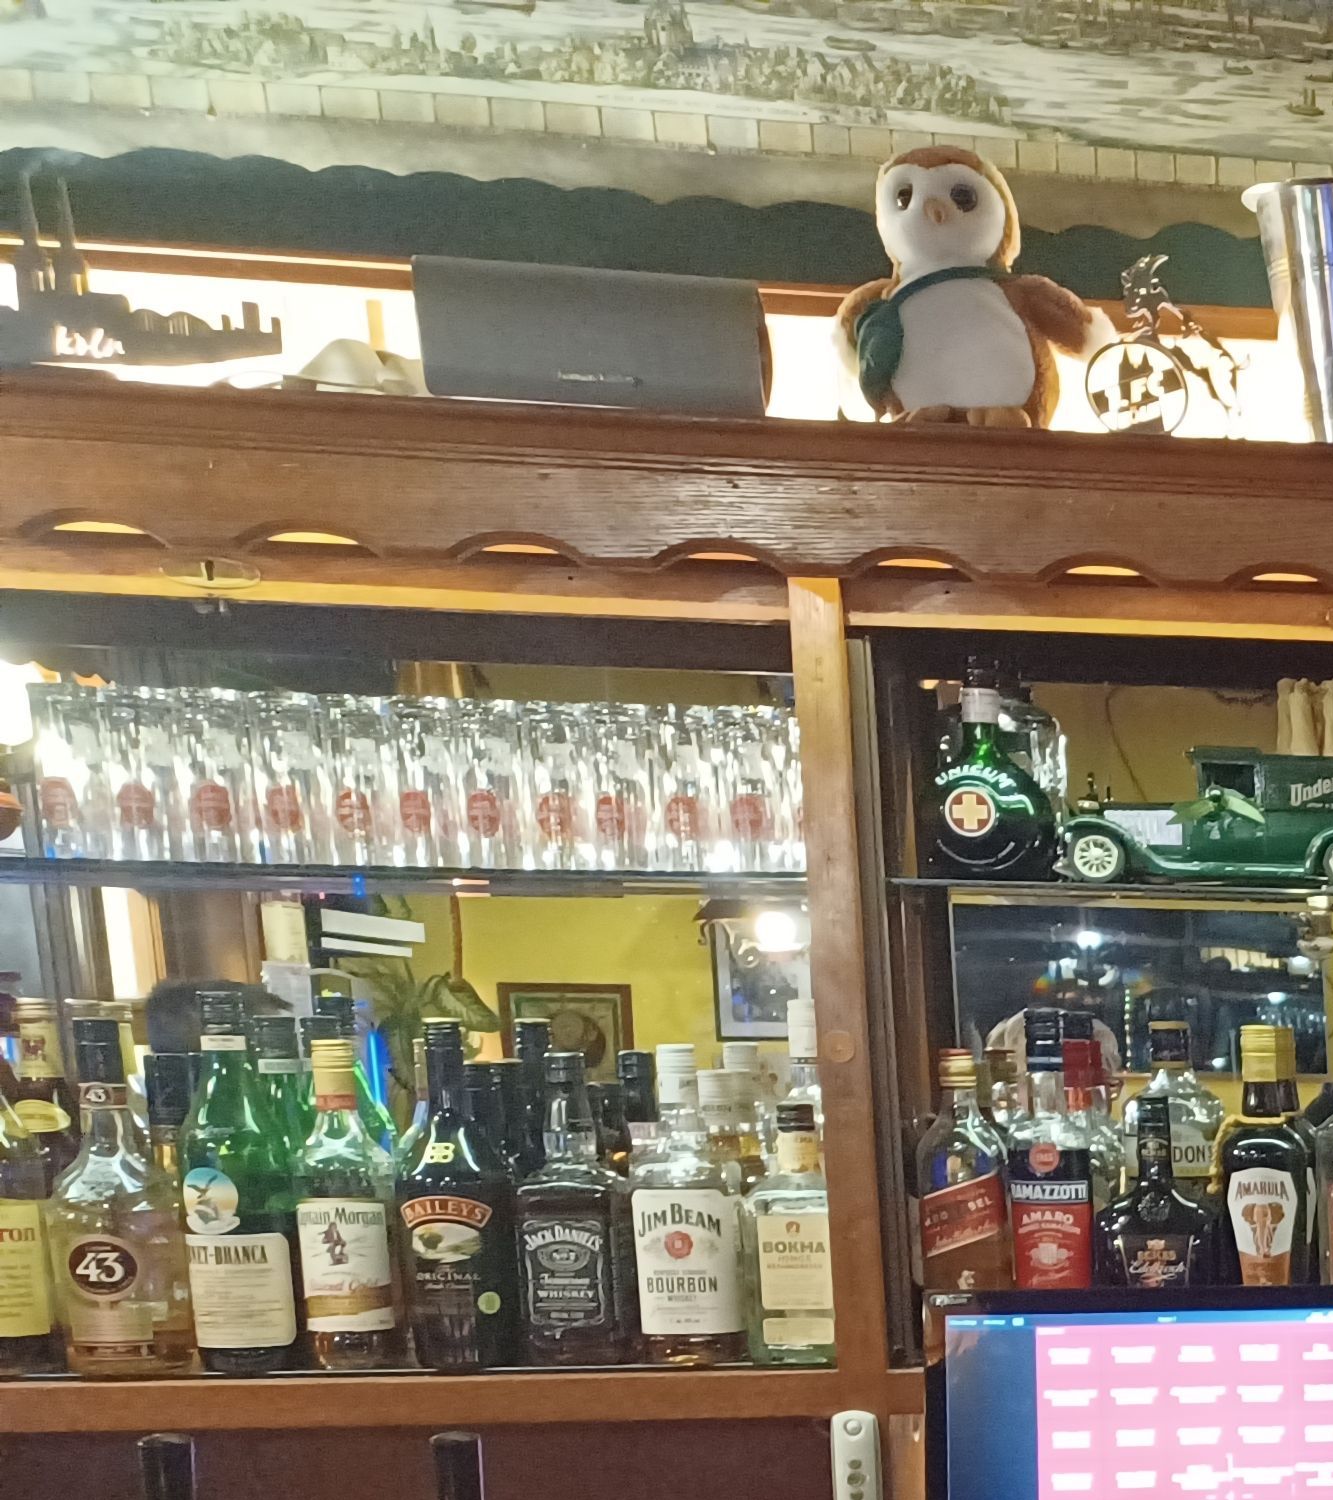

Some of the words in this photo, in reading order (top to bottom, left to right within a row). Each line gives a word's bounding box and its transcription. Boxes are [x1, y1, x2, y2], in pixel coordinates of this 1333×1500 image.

[935, 764, 1017, 790] UNICUM
[1010, 1183, 1087, 1201] RAMAZZOTTI
[404, 1200, 485, 1220] BAILEYS
[1021, 1210, 1075, 1226] AMARO
[638, 1210, 667, 1238] JIM
[670, 1202, 722, 1238] BEAM
[762, 1241, 826, 1254] BOKMA
[75, 1251, 125, 1283] 43
[646, 1275, 719, 1294] BOURBON
